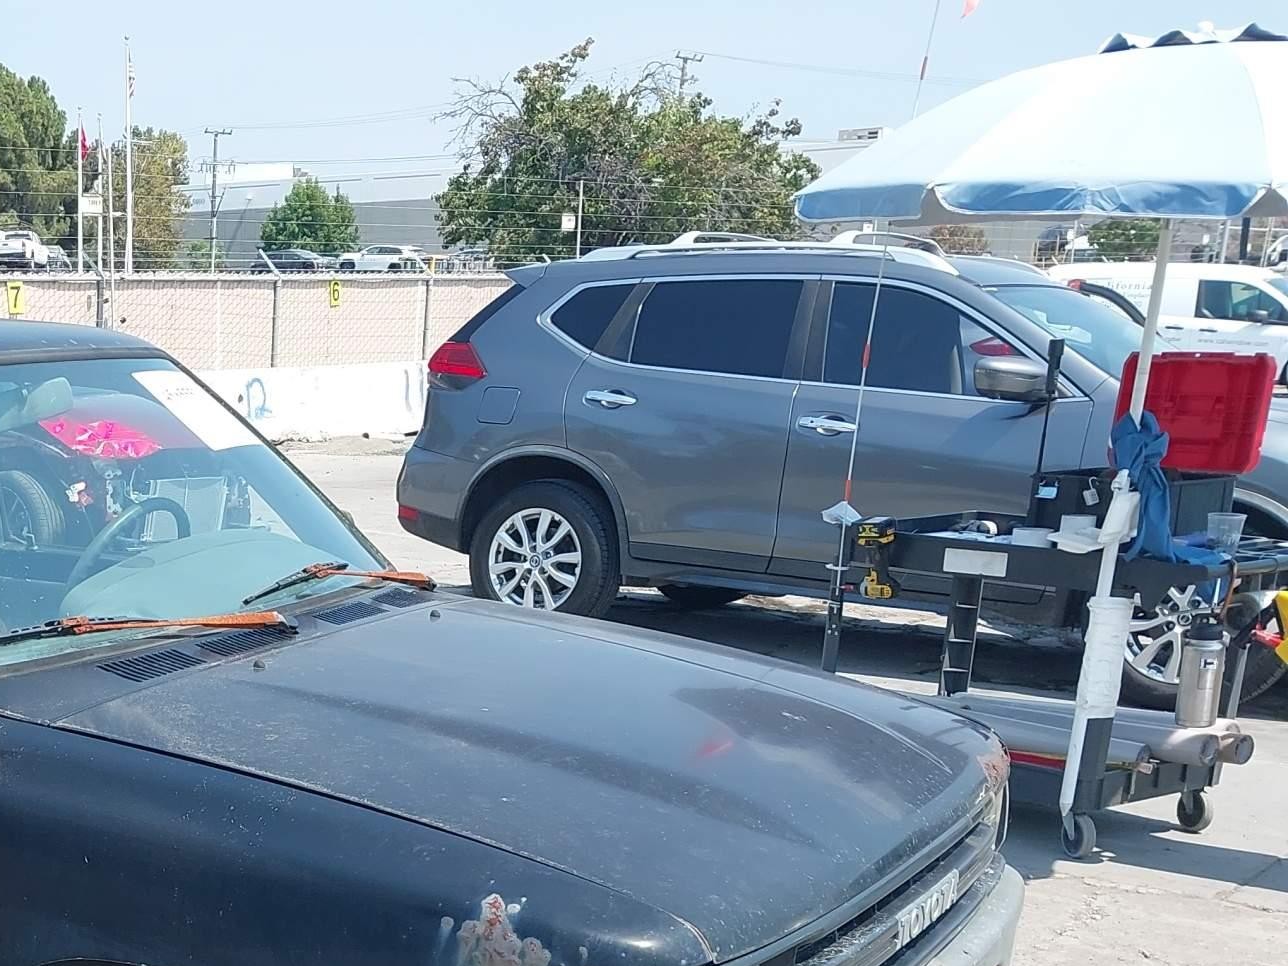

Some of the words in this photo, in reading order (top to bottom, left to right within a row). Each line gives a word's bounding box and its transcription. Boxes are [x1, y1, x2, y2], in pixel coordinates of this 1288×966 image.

[10, 286, 20, 308] 7
[333, 282, 339, 301] 6
[899, 875, 958, 948] TOYOTA
